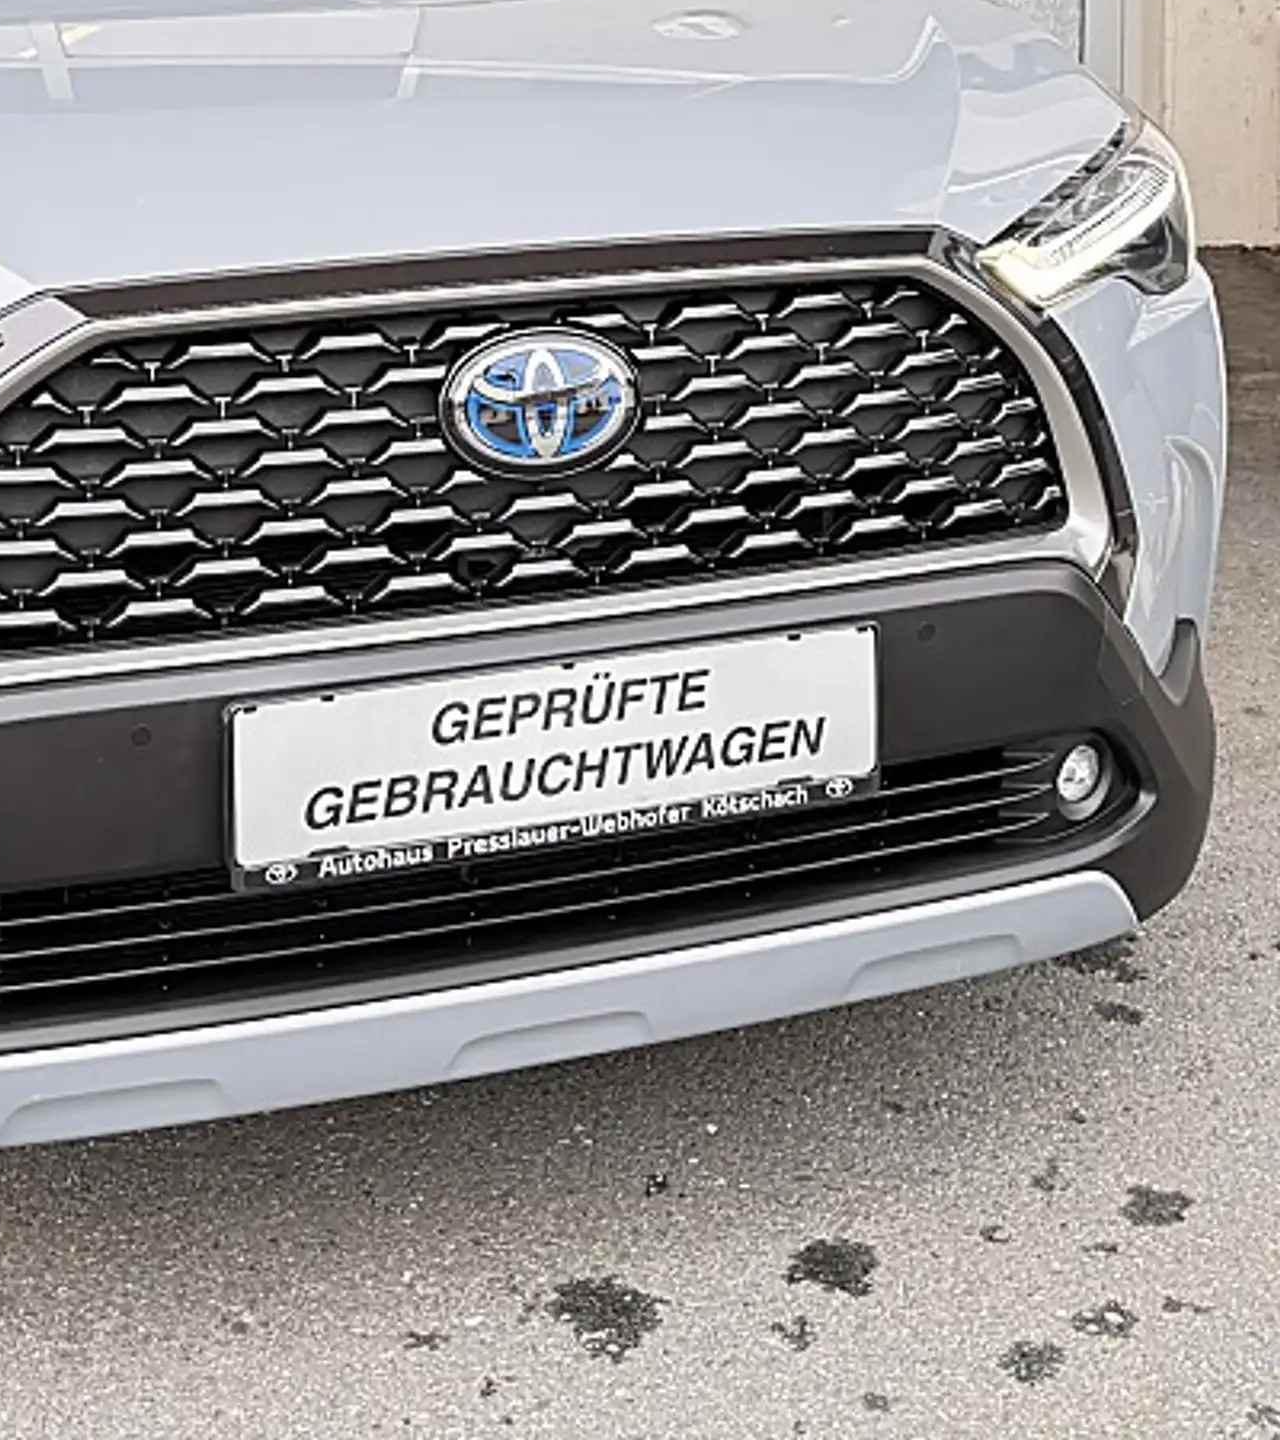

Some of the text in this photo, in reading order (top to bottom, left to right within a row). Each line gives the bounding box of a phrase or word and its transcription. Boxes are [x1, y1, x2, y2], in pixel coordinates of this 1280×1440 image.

[431, 669, 710, 745] GEPRÜFTE
[304, 716, 827, 830] GEBRAUCHTWAGEN
[317, 785, 809, 879] Autohaus Presslauer-Webhofer Kötschach
